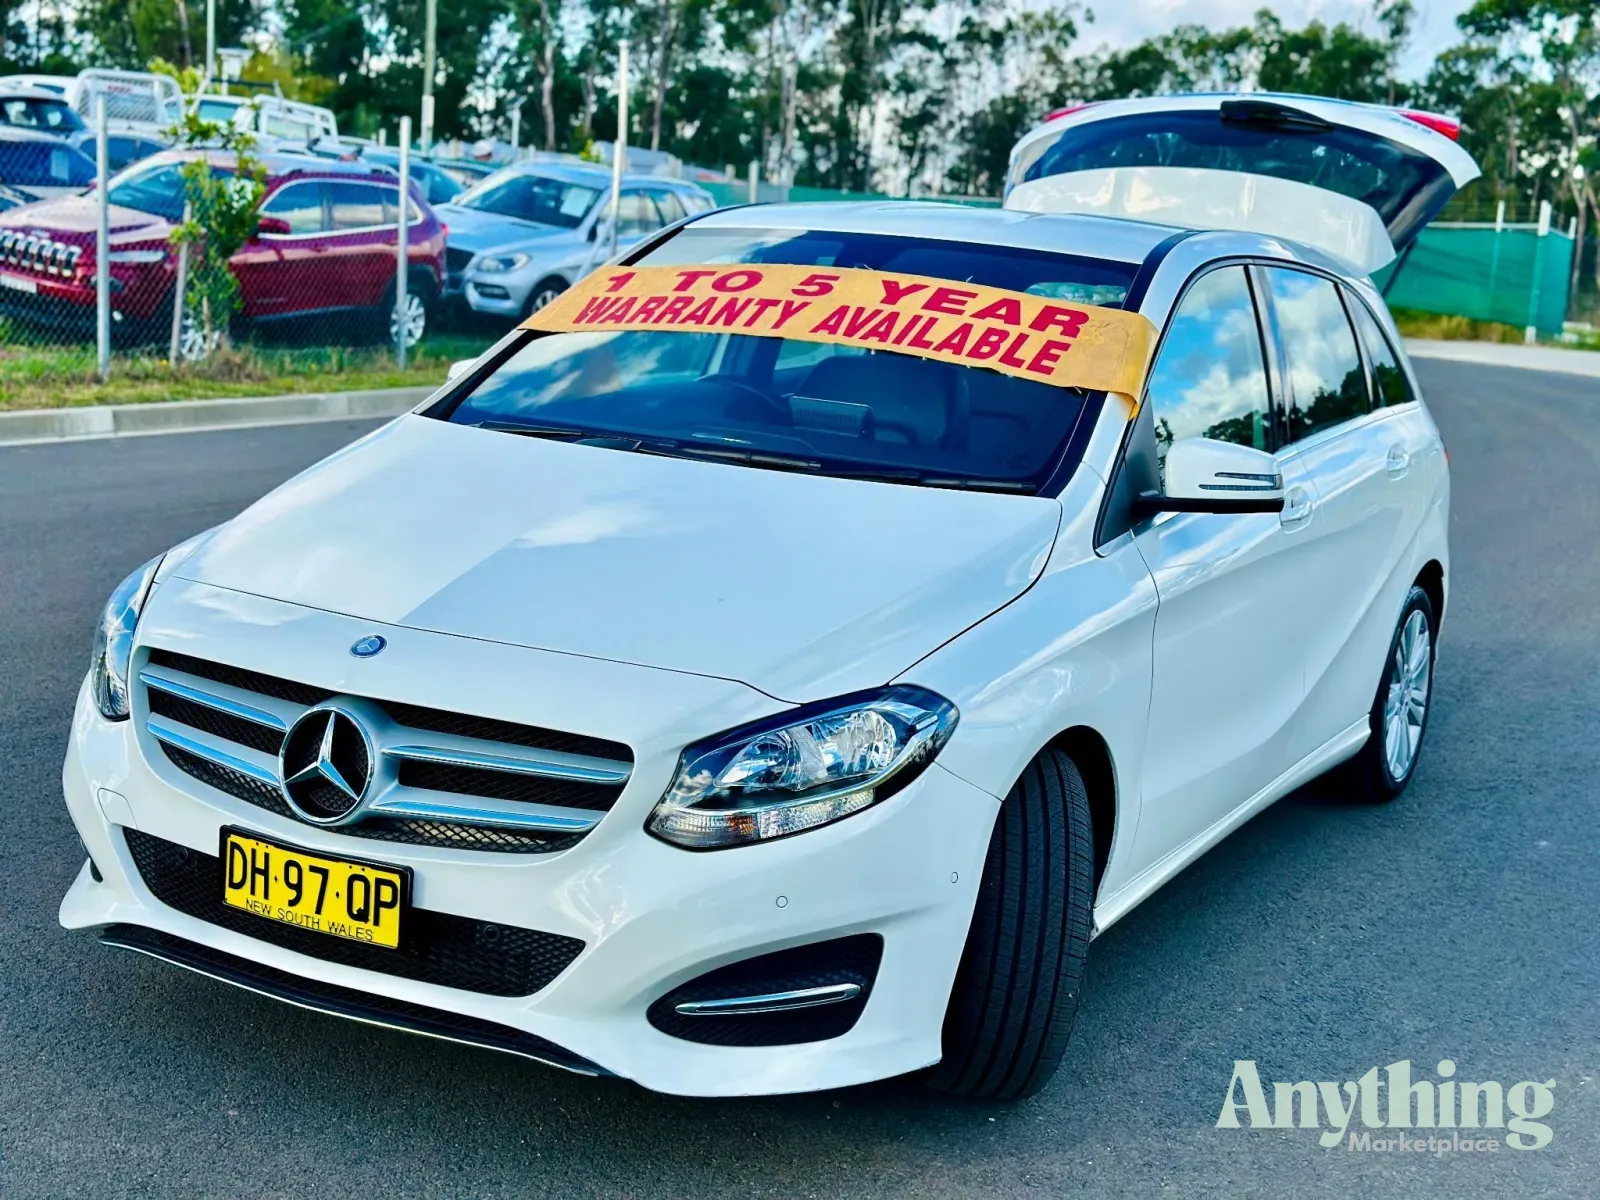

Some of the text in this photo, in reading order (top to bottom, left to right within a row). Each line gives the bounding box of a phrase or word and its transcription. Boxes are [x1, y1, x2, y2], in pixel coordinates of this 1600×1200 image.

[572, 296, 1072, 376] WARRANTY AVAILABLE
[605, 270, 1090, 339] 1 TO 5 YEAR
[246, 897, 374, 941] NEW SOUTH WALES
